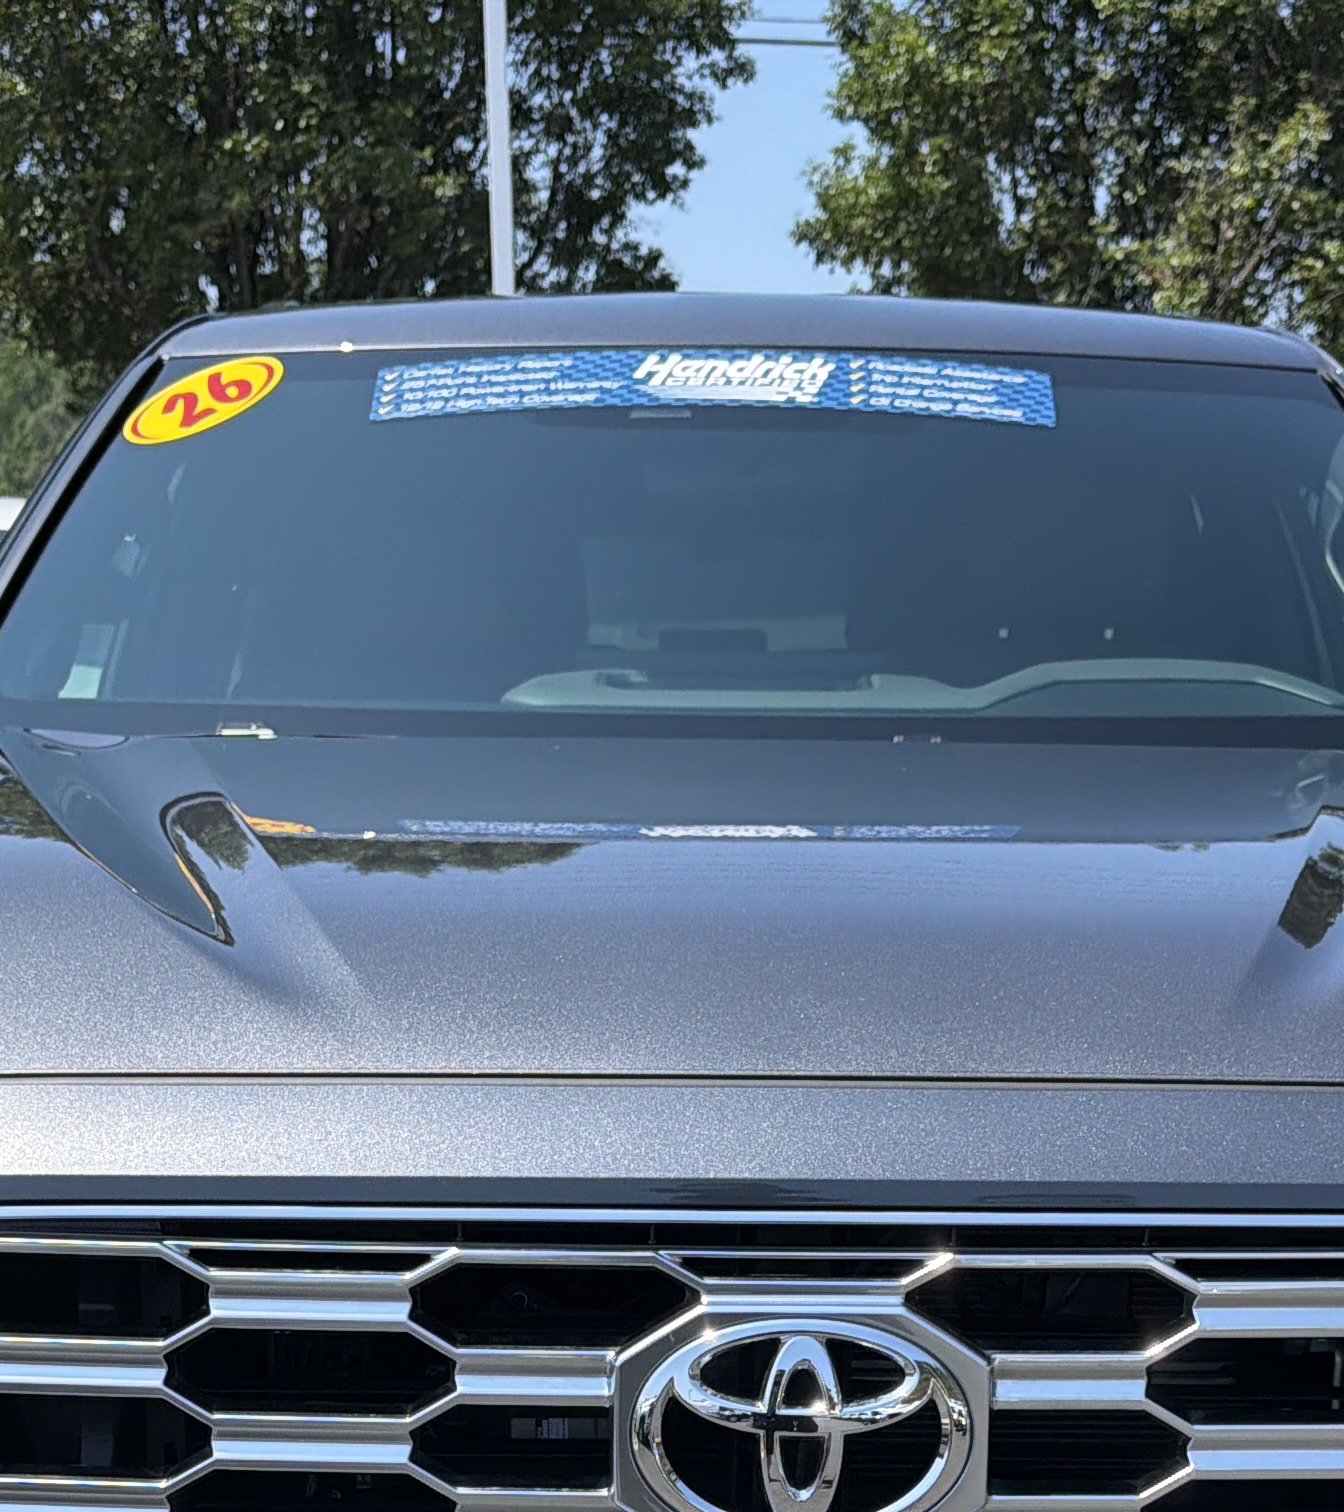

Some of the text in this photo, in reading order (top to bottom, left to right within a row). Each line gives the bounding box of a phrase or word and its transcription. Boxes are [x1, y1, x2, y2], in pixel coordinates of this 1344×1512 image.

[633, 353, 837, 386] Hendrick
[665, 377, 820, 389] CERTIFIED
[162, 372, 252, 428] 26
